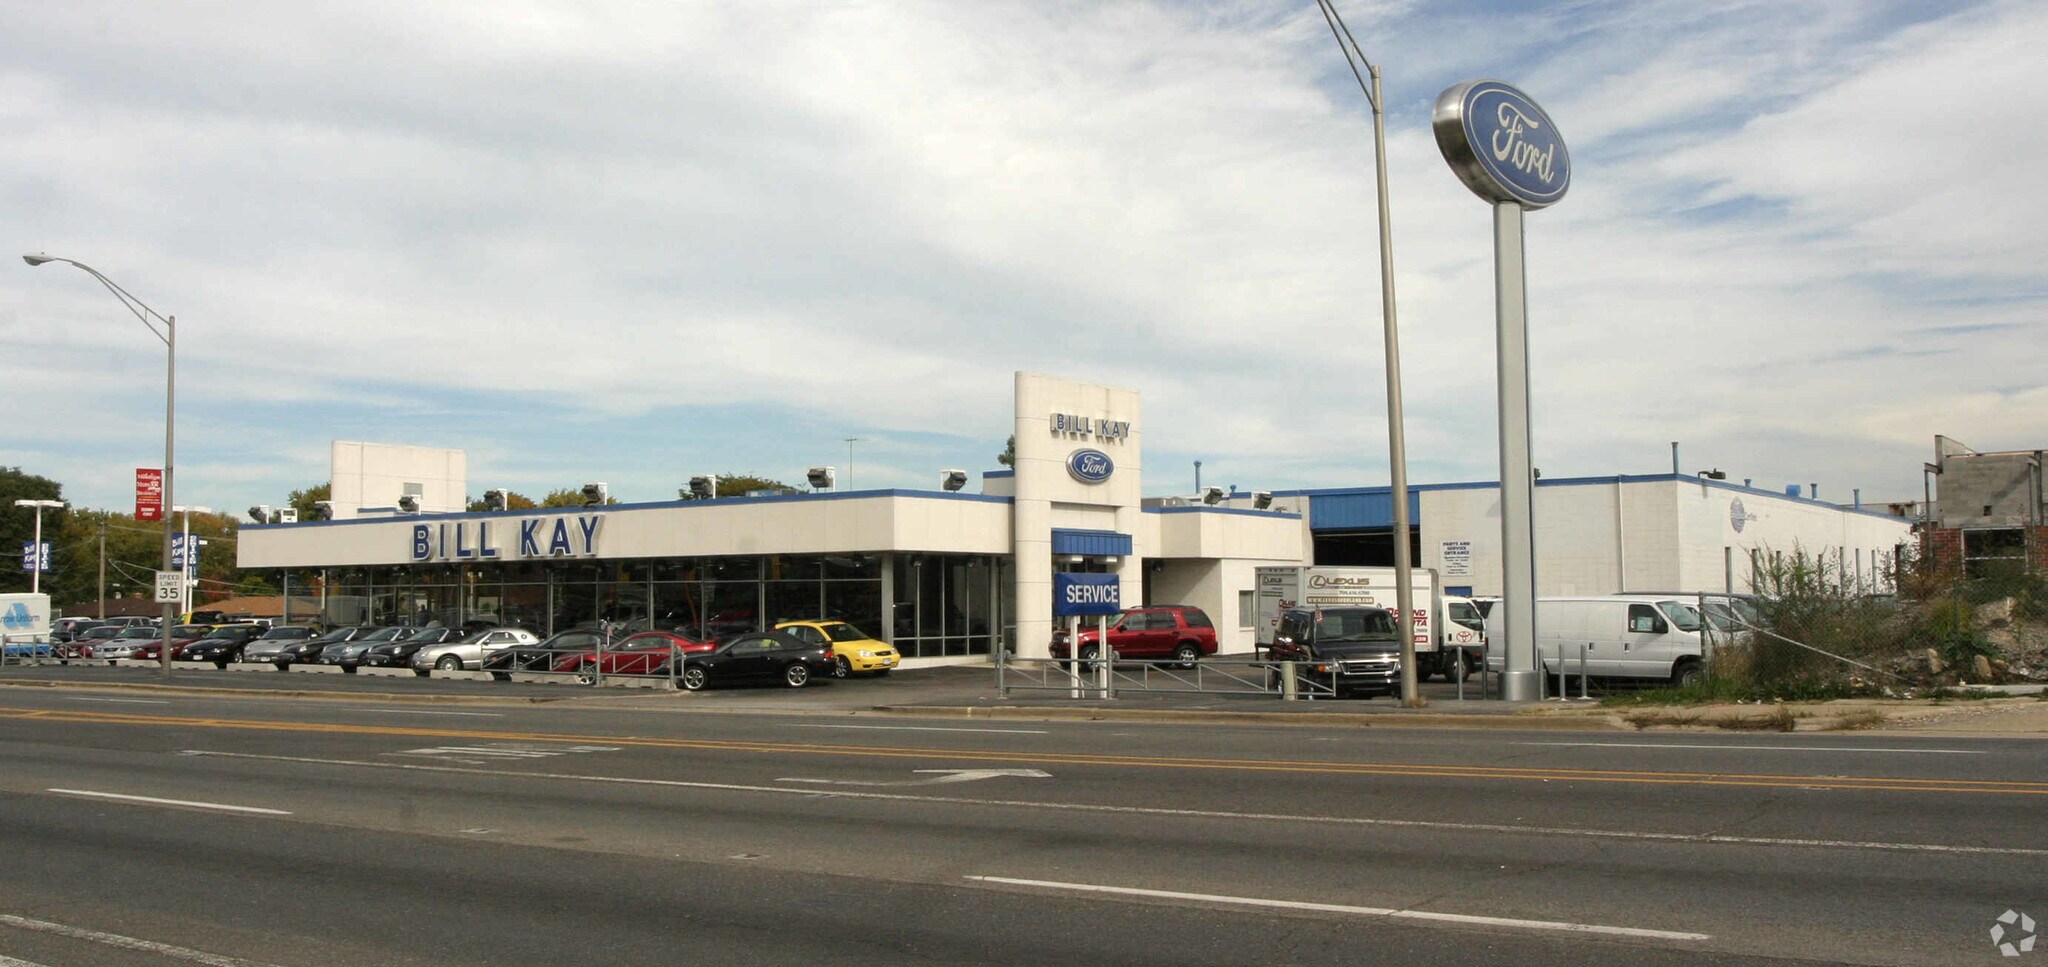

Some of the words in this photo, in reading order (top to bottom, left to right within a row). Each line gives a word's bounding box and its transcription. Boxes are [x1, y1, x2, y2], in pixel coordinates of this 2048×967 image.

[1492, 102, 1555, 184] Ford
[1056, 413, 1093, 434] BILL
[1101, 419, 1130, 438] KAY
[1081, 454, 1108, 475] Ford
[412, 521, 497, 561] BILL
[519, 514, 602, 557] KAY
[1326, 577, 1370, 586] LEXUS
[159, 587, 179, 599] 35
[1066, 584, 1118, 603] SERVICE
